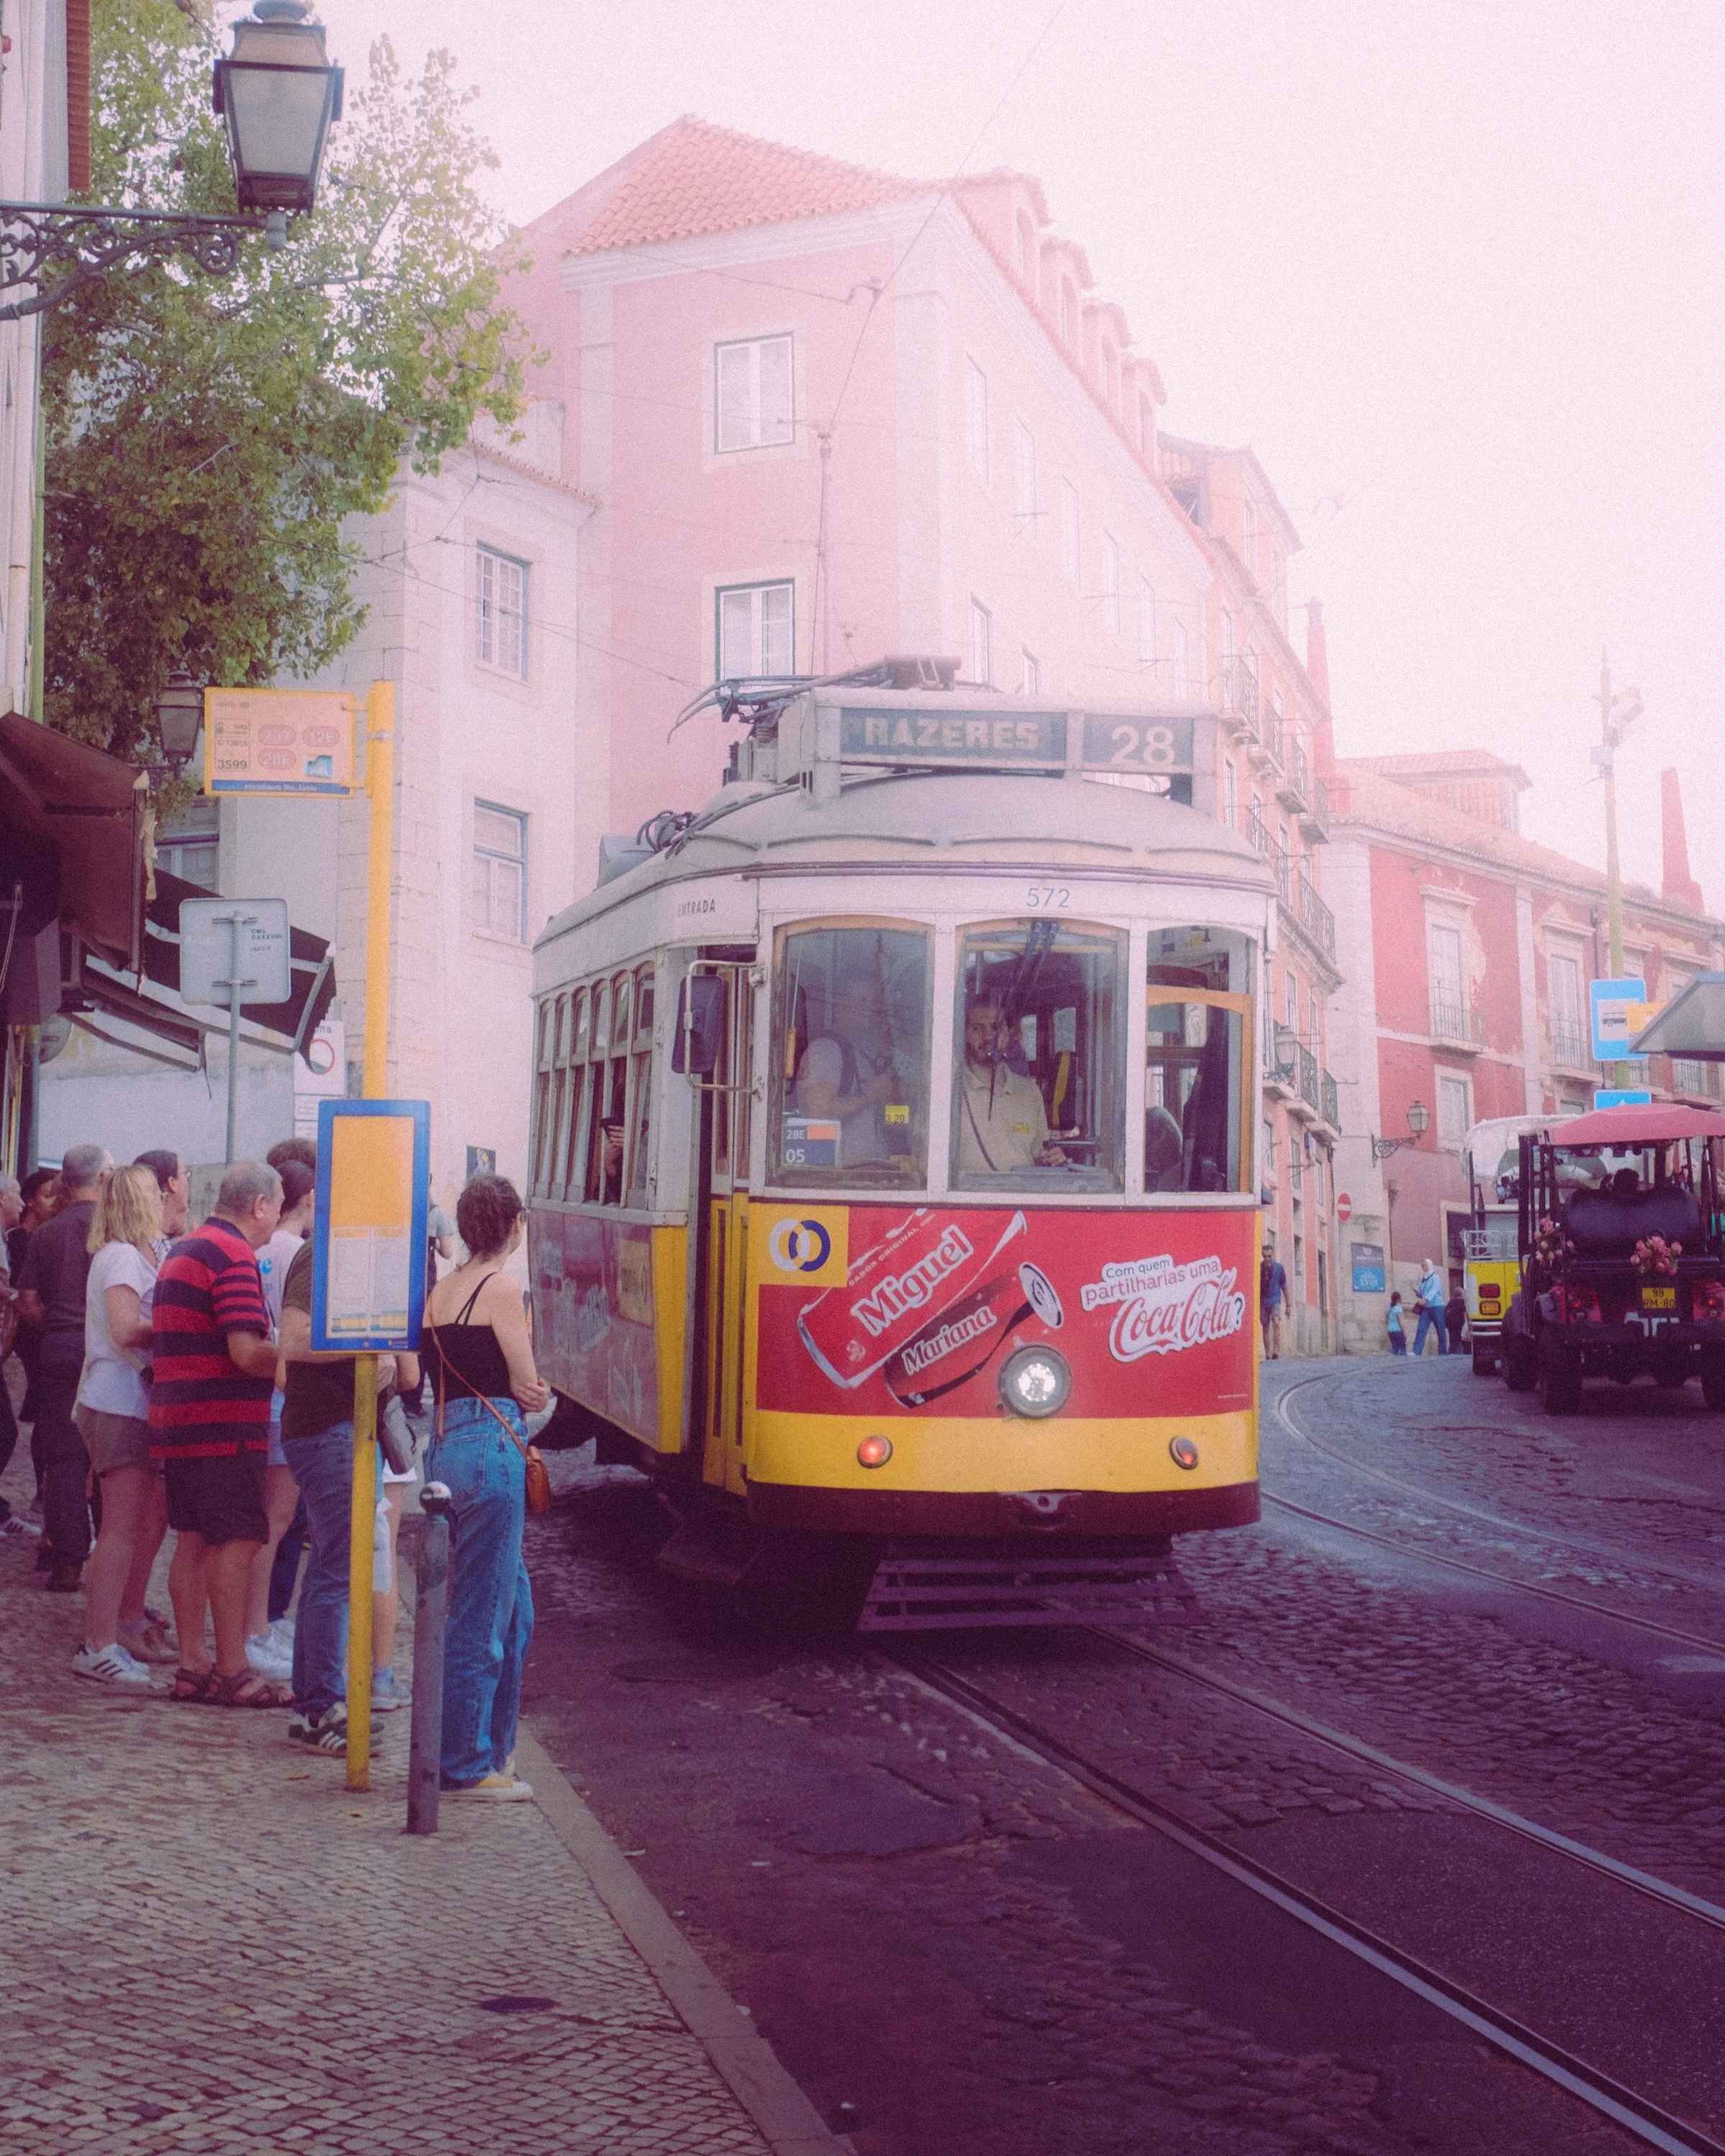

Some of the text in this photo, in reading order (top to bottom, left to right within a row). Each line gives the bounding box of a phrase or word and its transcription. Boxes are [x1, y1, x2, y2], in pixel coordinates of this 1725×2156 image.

[1110, 725, 1175, 765] 28
[217, 760, 247, 770] 3599
[678, 900, 715, 916] ENTRADA
[1026, 888, 1070, 908] 572
[786, 1129, 806, 1140] 28E
[786, 1148, 806, 1164] 05
[849, 1227, 920, 1286] SABOR ORIGINAL
[1106, 1258, 1170, 1279] Com quem
[851, 1225, 973, 1336] Miguel
[1085, 1260, 1219, 1305] partilharias uma
[901, 1306, 997, 1375] Mariana
